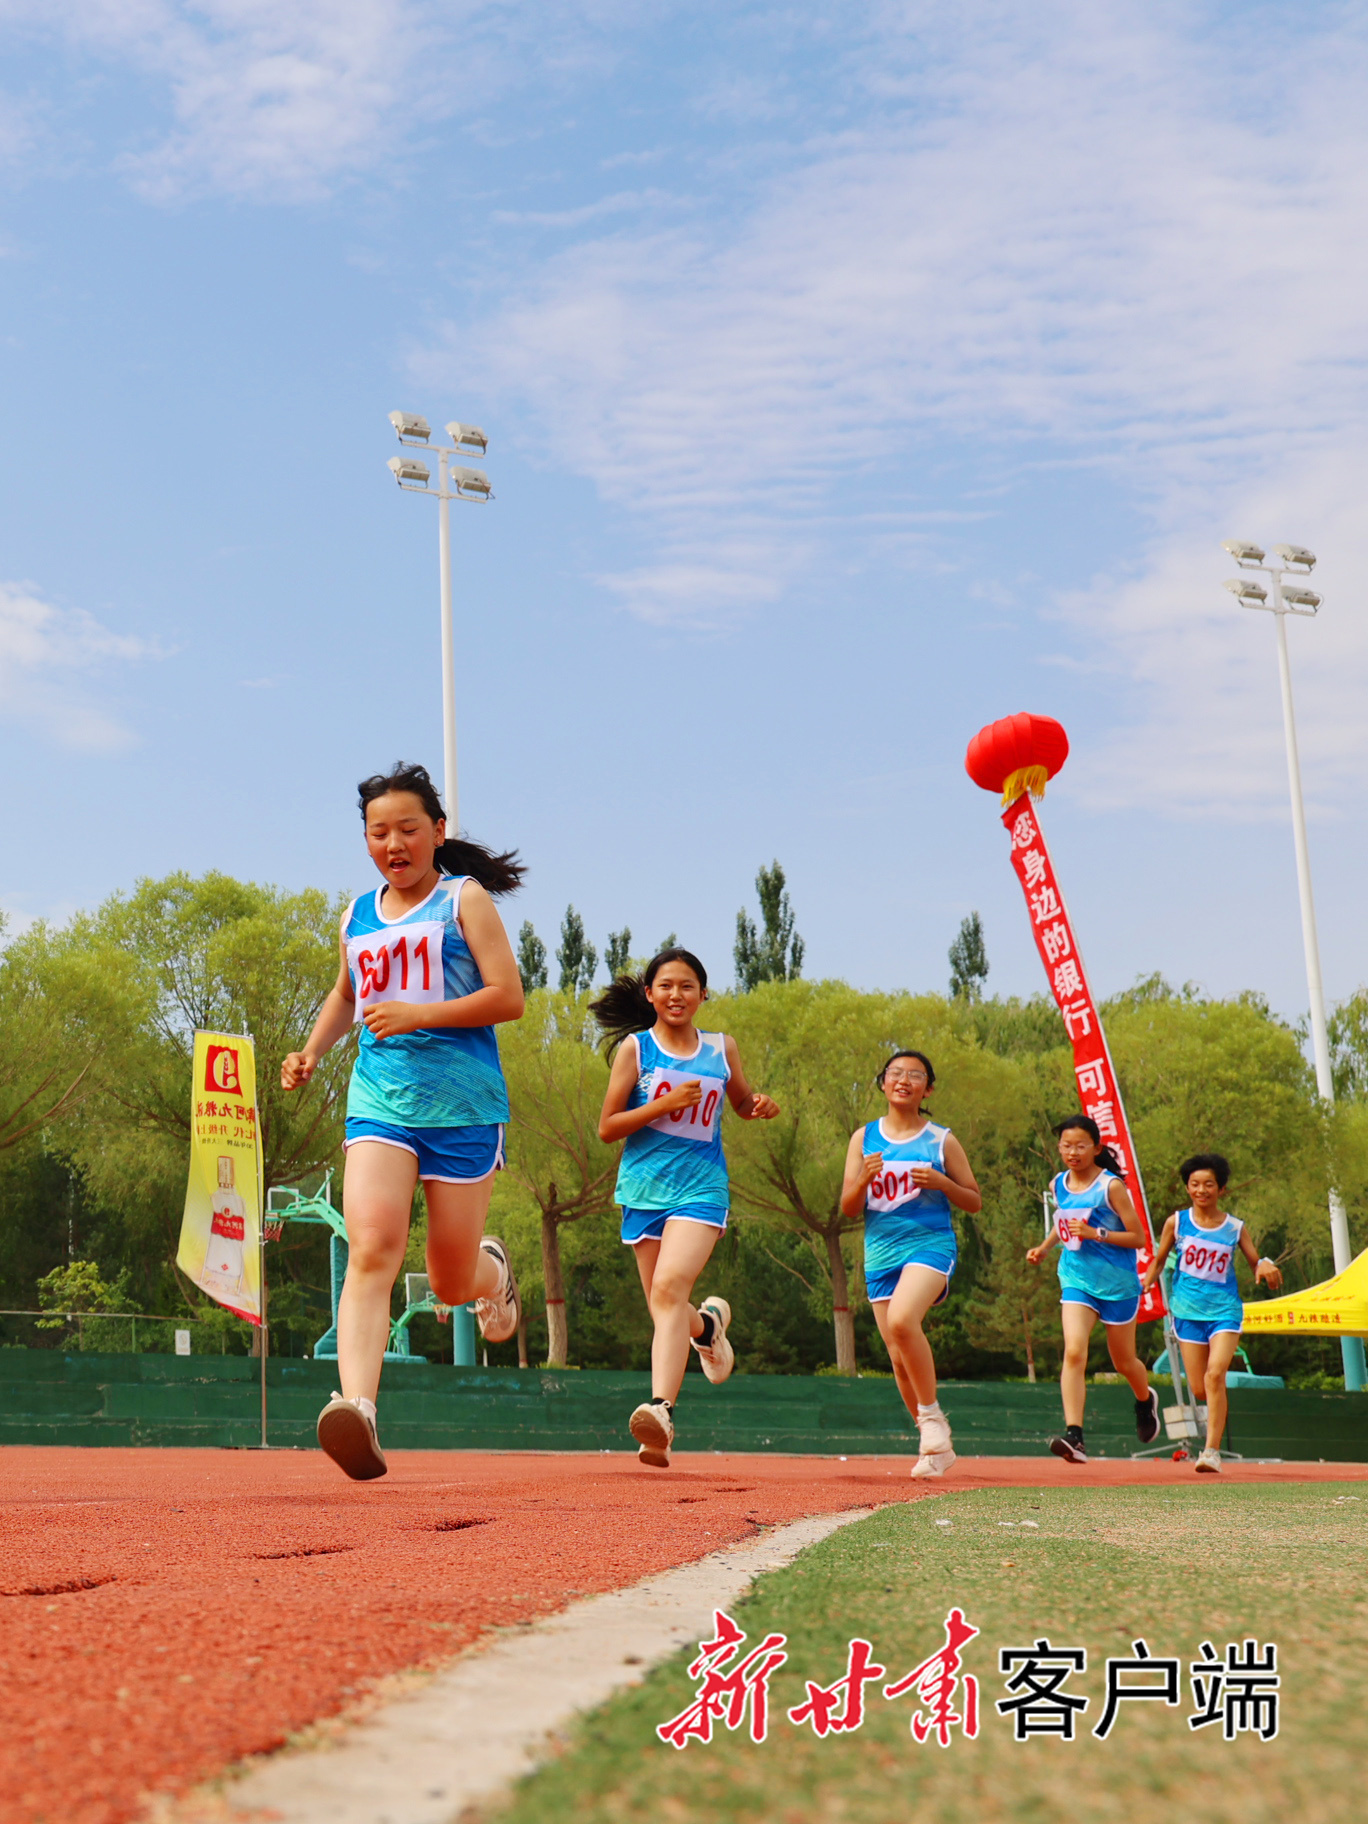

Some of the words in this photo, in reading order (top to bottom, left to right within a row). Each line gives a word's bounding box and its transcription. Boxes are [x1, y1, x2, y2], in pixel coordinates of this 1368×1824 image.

[1011, 811, 1092, 1041] 您身边的银行
[358, 936, 430, 999] 6011
[871, 1170, 919, 1202] 601
[1185, 1244, 1229, 1274] 6015
